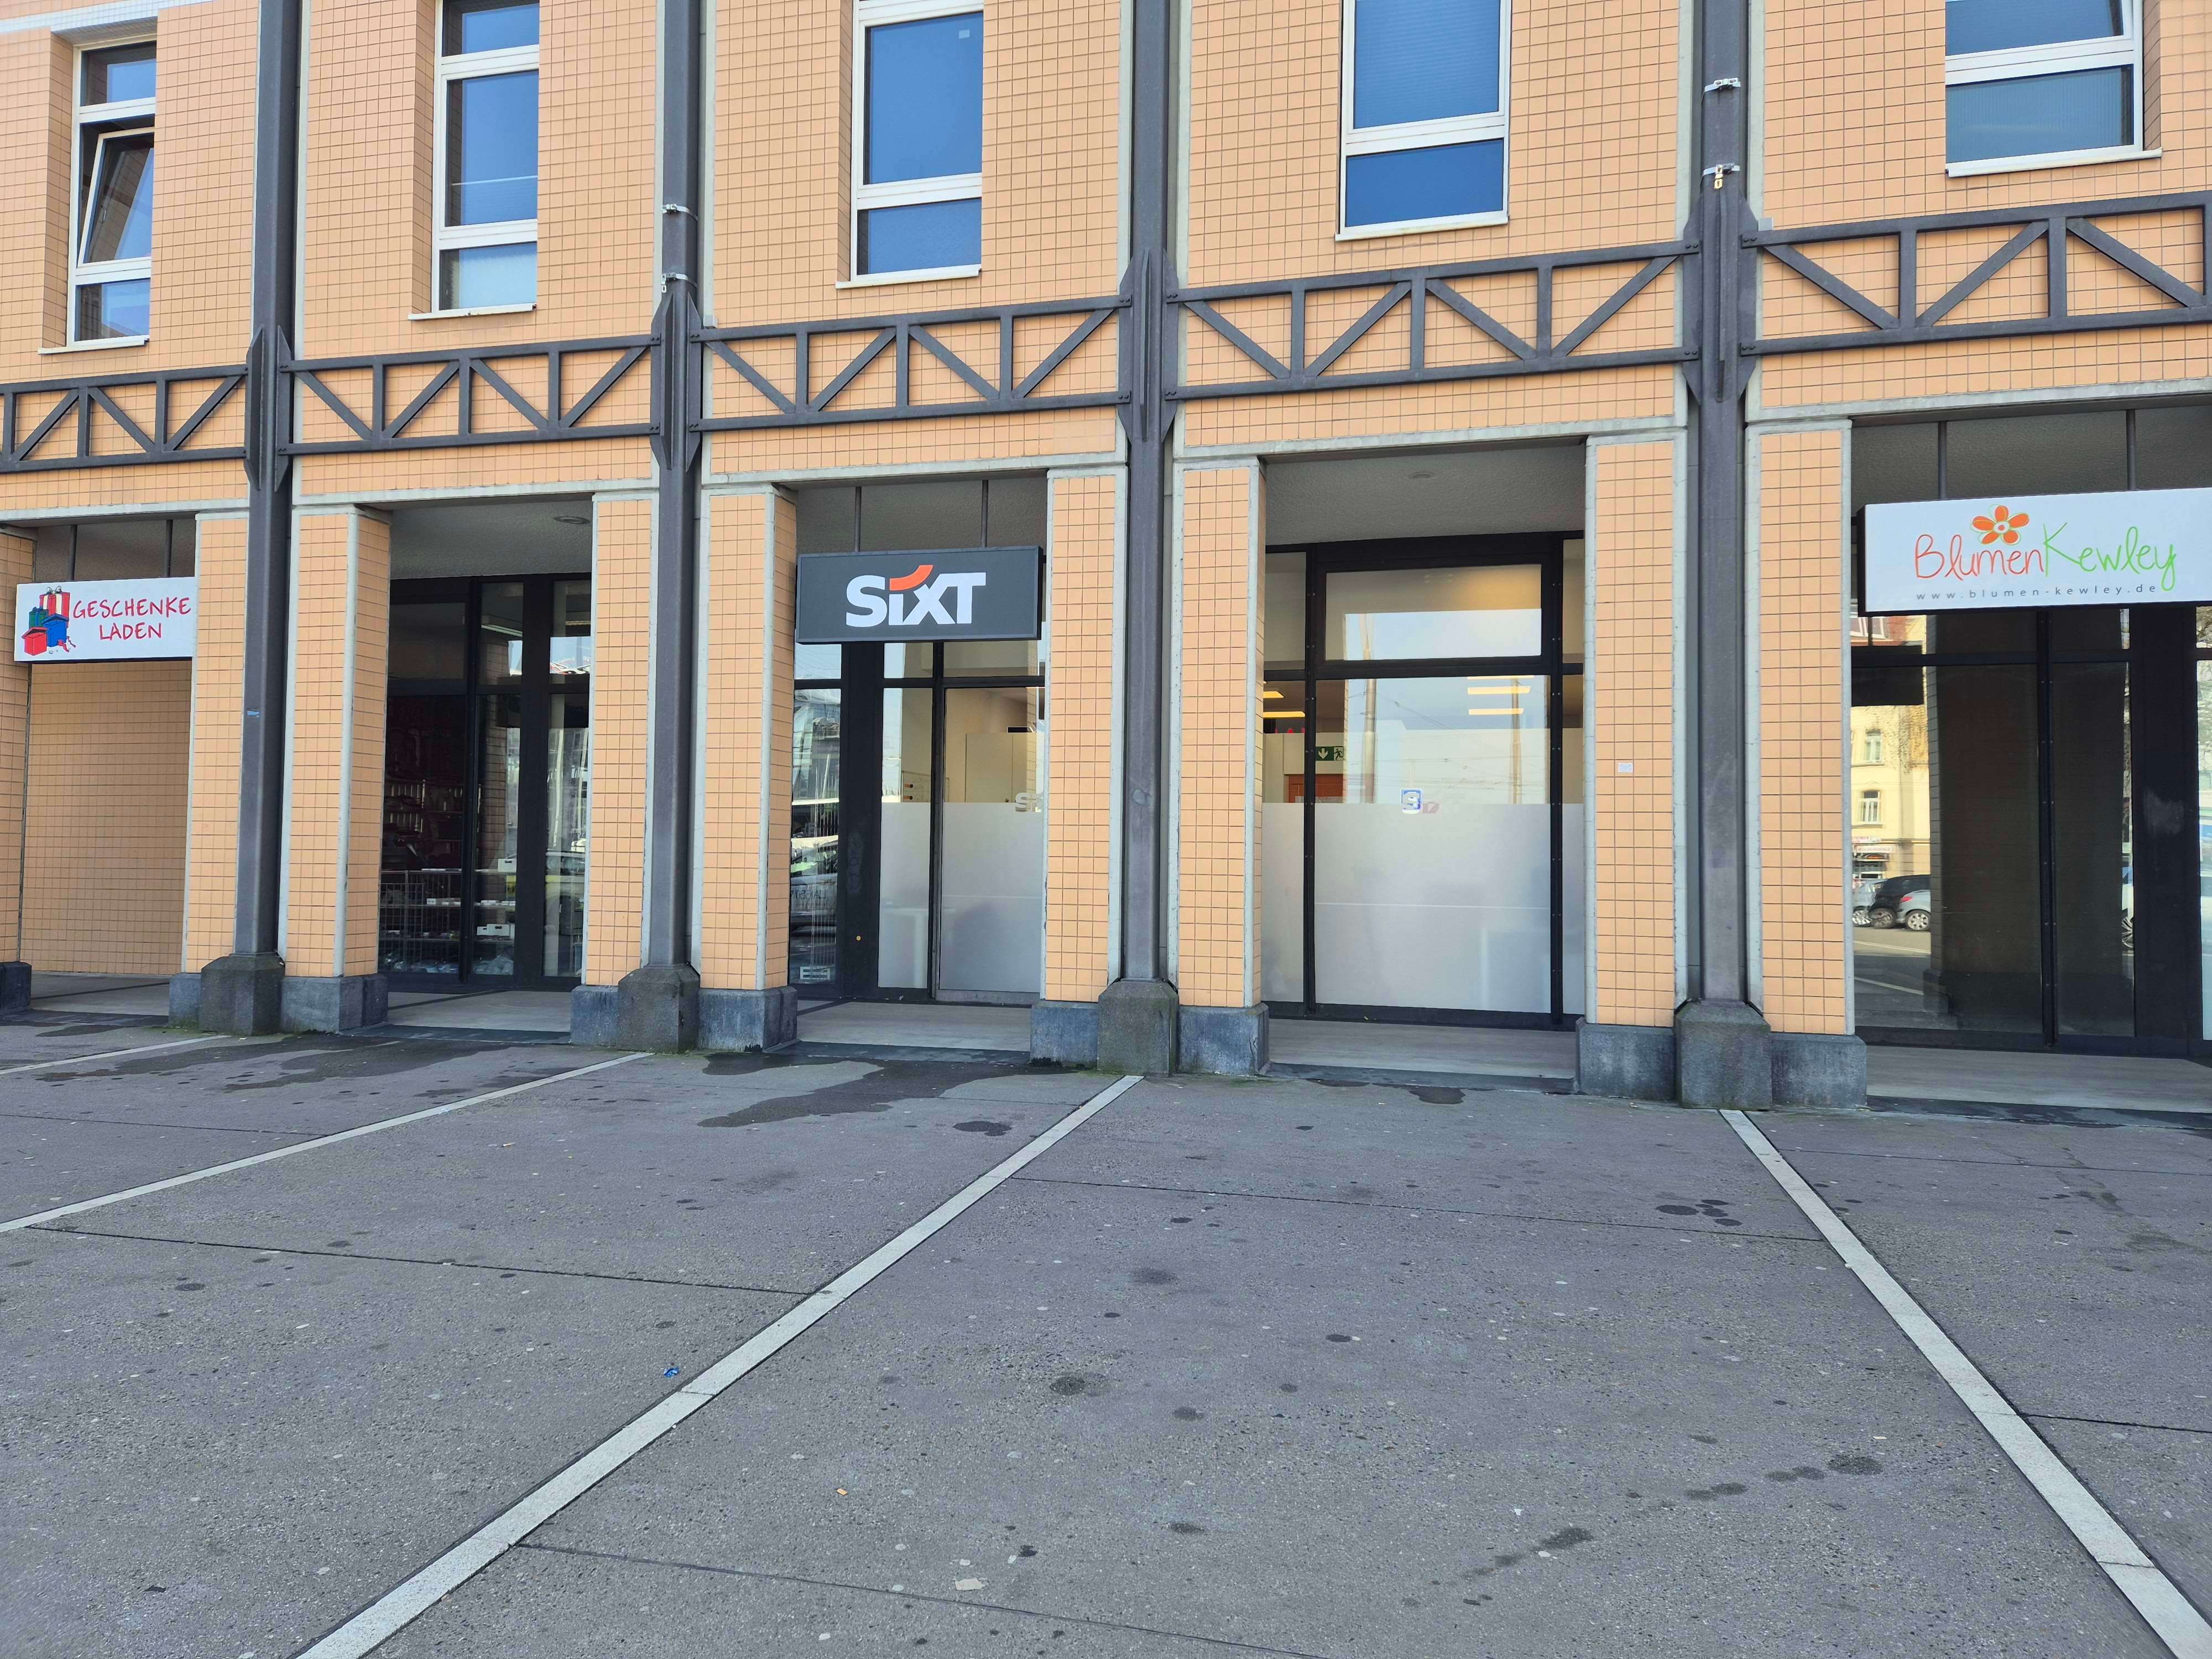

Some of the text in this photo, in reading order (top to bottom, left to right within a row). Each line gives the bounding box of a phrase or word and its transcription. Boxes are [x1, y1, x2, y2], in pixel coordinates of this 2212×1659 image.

[1916, 583, 2156, 600] www.blumen-kewley.de
[72, 596, 192, 619] GESCHENKE
[99, 622, 162, 641] LADEN
